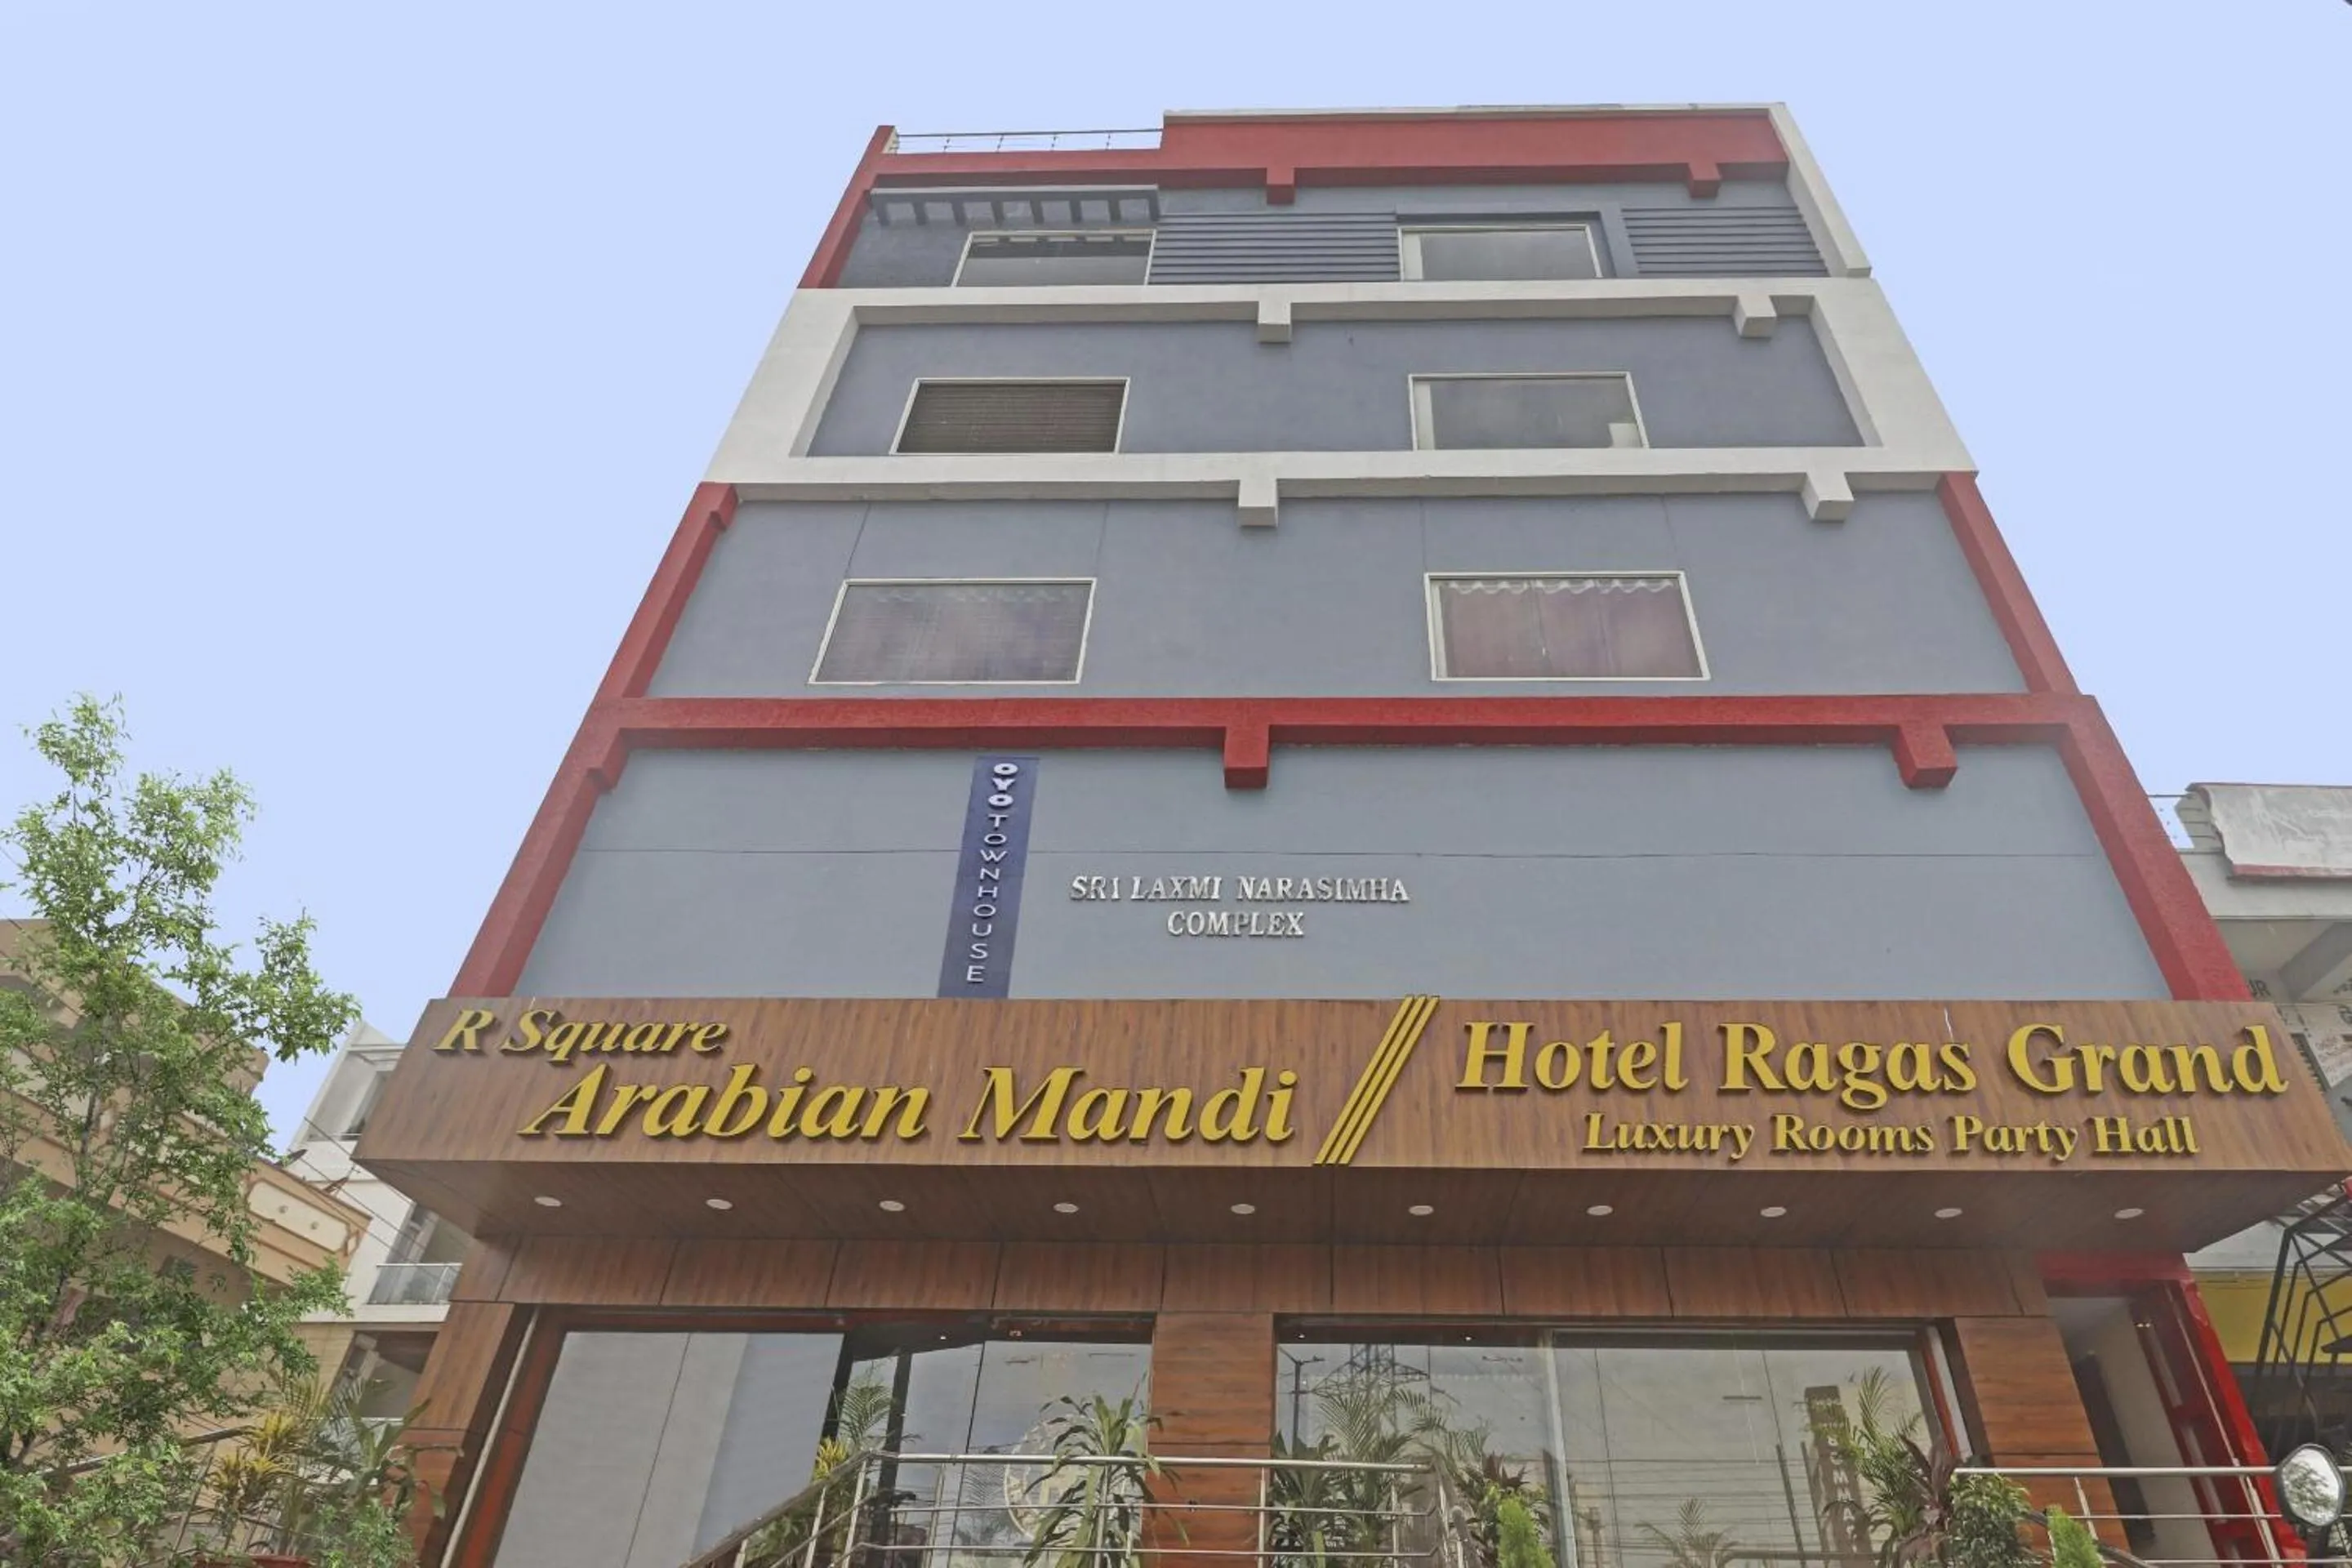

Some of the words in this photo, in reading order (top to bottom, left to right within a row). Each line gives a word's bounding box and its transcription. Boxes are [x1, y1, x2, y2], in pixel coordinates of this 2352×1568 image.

[987, 762, 1018, 807] OYO
[966, 814, 1009, 982] TOWNHOUSE
[1071, 875, 1120, 900] SRI
[1130, 875, 1223, 900] LAXMI
[1236, 876, 1410, 902] NARASIMHA
[1167, 911, 1304, 936] COMPLEX
[434, 1009, 494, 1051] R
[501, 1009, 728, 1062] Square
[1455, 1021, 1690, 1091] Hotel
[1718, 1022, 1978, 1111] Ragas
[2007, 1022, 2290, 1094] Grand
[517, 1063, 933, 1139] Arabian
[958, 1067, 1298, 1142] Mandi
[1583, 1112, 1756, 1160] Luxury
[1773, 1114, 1936, 1153] Rooms
[1949, 1115, 2078, 1162] Party
[2091, 1116, 2200, 1154] Hall
